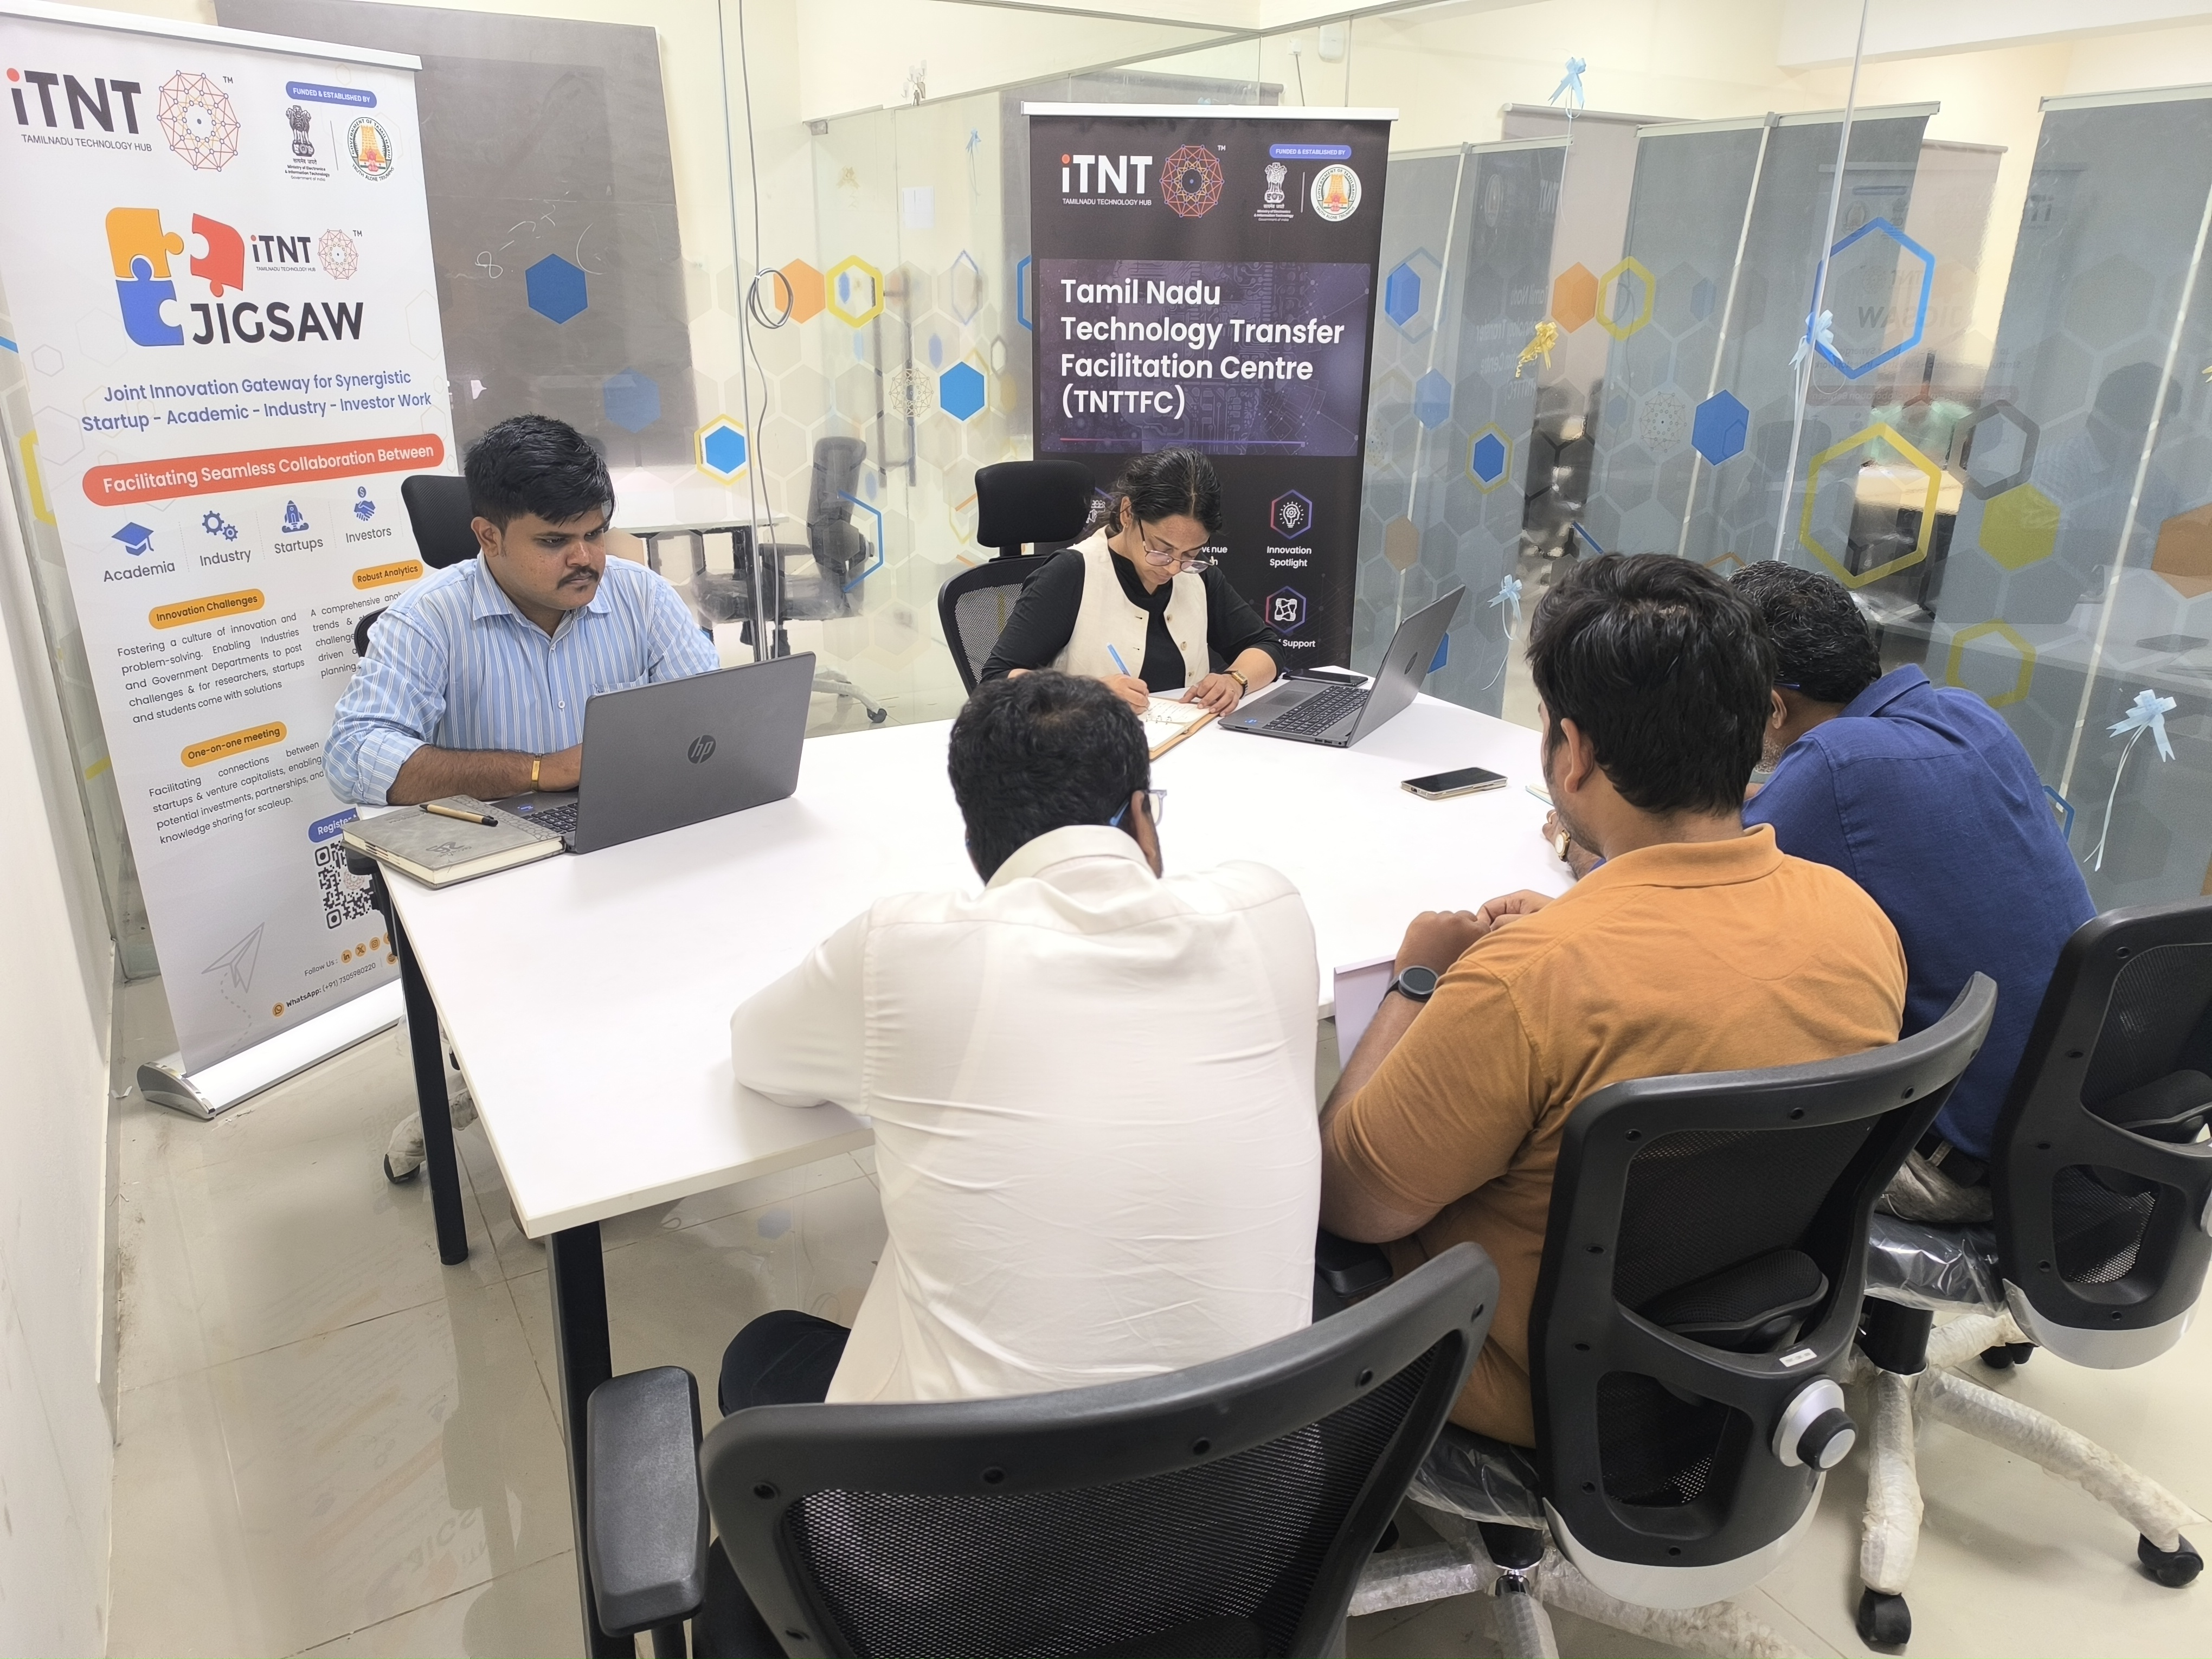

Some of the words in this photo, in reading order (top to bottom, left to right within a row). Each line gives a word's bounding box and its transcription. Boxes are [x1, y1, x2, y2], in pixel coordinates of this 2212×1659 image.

[7, 68, 141, 134] iTNT
[293, 88, 317, 96] FUNDED
[323, 91, 361, 101] ESTABLISHED
[21, 134, 73, 145] TAMILNADU
[75, 138, 132, 150] TECHNOLOGY
[134, 143, 152, 151] HUB
[352, 163, 364, 177] TRUTH
[1062, 154, 1152, 194] iTNT
[251, 235, 311, 263] iTNT
[1061, 278, 1138, 303] Tamil
[1147, 280, 1220, 305] Nadu
[190, 302, 363, 344] JIGSAW
[1061, 316, 1223, 350] Technology
[1230, 316, 1344, 343] Transfer
[1062, 352, 1212, 378] Facilitation
[1220, 356, 1313, 380] Centre
[104, 384, 147, 401] Joint
[150, 379, 238, 398] Innovation
[242, 378, 310, 394] Gateway
[314, 374, 331, 388] for
[336, 370, 411, 391] Synergistic
[82, 414, 149, 431] Startup
[167, 404, 249, 425] Academic
[264, 401, 326, 416] Industry
[340, 396, 395, 411] Investor
[398, 392, 431, 406] Work
[1063, 383, 1185, 419] (TNTTFC)
[103, 470, 198, 493] Facilitating
[201, 462, 276, 481] Seamless
[279, 451, 375, 472] Collaboration
[378, 447, 433, 461] Between
[275, 539, 323, 554] Startups
[346, 528, 391, 543] Investors
[1267, 546, 1311, 554] Innovation
[104, 561, 175, 582] Academia
[200, 550, 250, 566] Industry
[1270, 558, 1307, 568] Spotlight
[358, 572, 382, 582] Robust
[384, 566, 418, 577] Analytics
[157, 606, 205, 621] Innovation
[207, 596, 257, 610] Challenges
[321, 598, 380, 614] comprehensive
[118, 642, 165, 657] Fostering
[182, 632, 212, 644] culture
[217, 627, 225, 636] of
[231, 619, 276, 633] innovation
[281, 613, 296, 623] and
[313, 620, 339, 632] trends
[122, 651, 203, 676] problem-solving.
[213, 641, 250, 654] Enabling
[261, 630, 299, 644] Industries
[318, 651, 343, 661] driven
[1283, 640, 1316, 649] Support
[126, 679, 146, 690] and
[152, 665, 208, 685] Government
[212, 653, 269, 671] Departments
[285, 644, 302, 657] post
[129, 690, 183, 706] challenges
[199, 682, 210, 691] for
[215, 670, 268, 686] researchers,
[273, 660, 304, 673] startups
[133, 712, 154, 723] and
[157, 703, 196, 718] students
[198, 696, 222, 707] come
[224, 690, 242, 700] with
[244, 682, 282, 696] solutions
[188, 739, 242, 759] One-on-one
[244, 729, 280, 743] meeting
[689, 735, 715, 764] hp
[149, 778, 201, 797] Facilitating
[218, 757, 269, 777] connections
[286, 742, 319, 757] between
[153, 797, 193, 812] startups
[206, 782, 237, 797] venture
[241, 769, 285, 785] capitalists,
[289, 757, 321, 771] enabling
[157, 809, 199, 831] potential
[201, 794, 253, 815] investments,
[255, 777, 307, 798] partnerships,
[310, 770, 324, 780] and
[160, 824, 210, 844] knowledge
[213, 812, 243, 827] sharing
[245, 808, 255, 816] for
[258, 798, 293, 812] scaleup.
[305, 964, 324, 976] Follow
[286, 988, 321, 1007] WhatsApp:
[323, 980, 338, 992] (+91)
[339, 963, 376, 984] 7305980220
